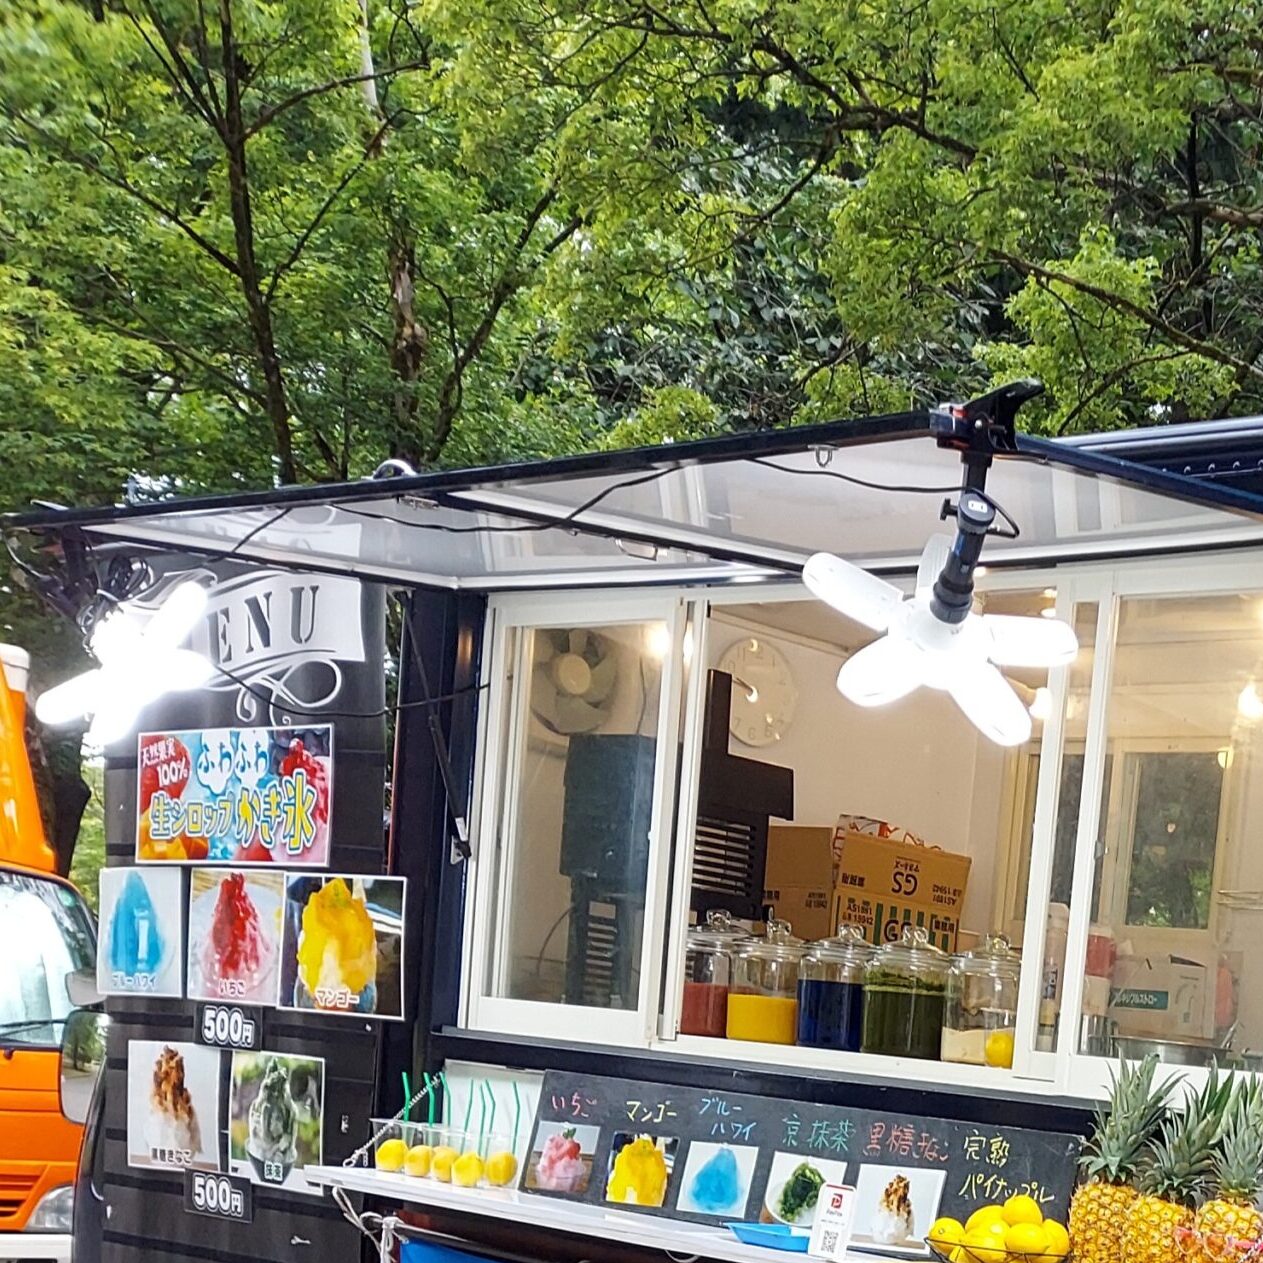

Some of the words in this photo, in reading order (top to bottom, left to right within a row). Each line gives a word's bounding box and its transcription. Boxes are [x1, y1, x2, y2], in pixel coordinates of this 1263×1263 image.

[205, 583, 320, 664] ENU
[141, 738, 176, 767] 天然果実
[197, 740, 269, 777] ふわふわ
[157, 758, 190, 788] 100%
[218, 980, 245, 997] いちご
[315, 989, 361, 1008] マンゴー
[203, 1006, 254, 1046] 500円
[552, 1091, 598, 1118] いちご
[625, 1101, 678, 1123] マンゴー
[699, 1097, 742, 1116] ブルー
[711, 1121, 757, 1141] ハワイ
[963, 1129, 1011, 1168] 完熟
[193, 1175, 243, 1216] 500円
[958, 1173, 1055, 1203] パイナップル
